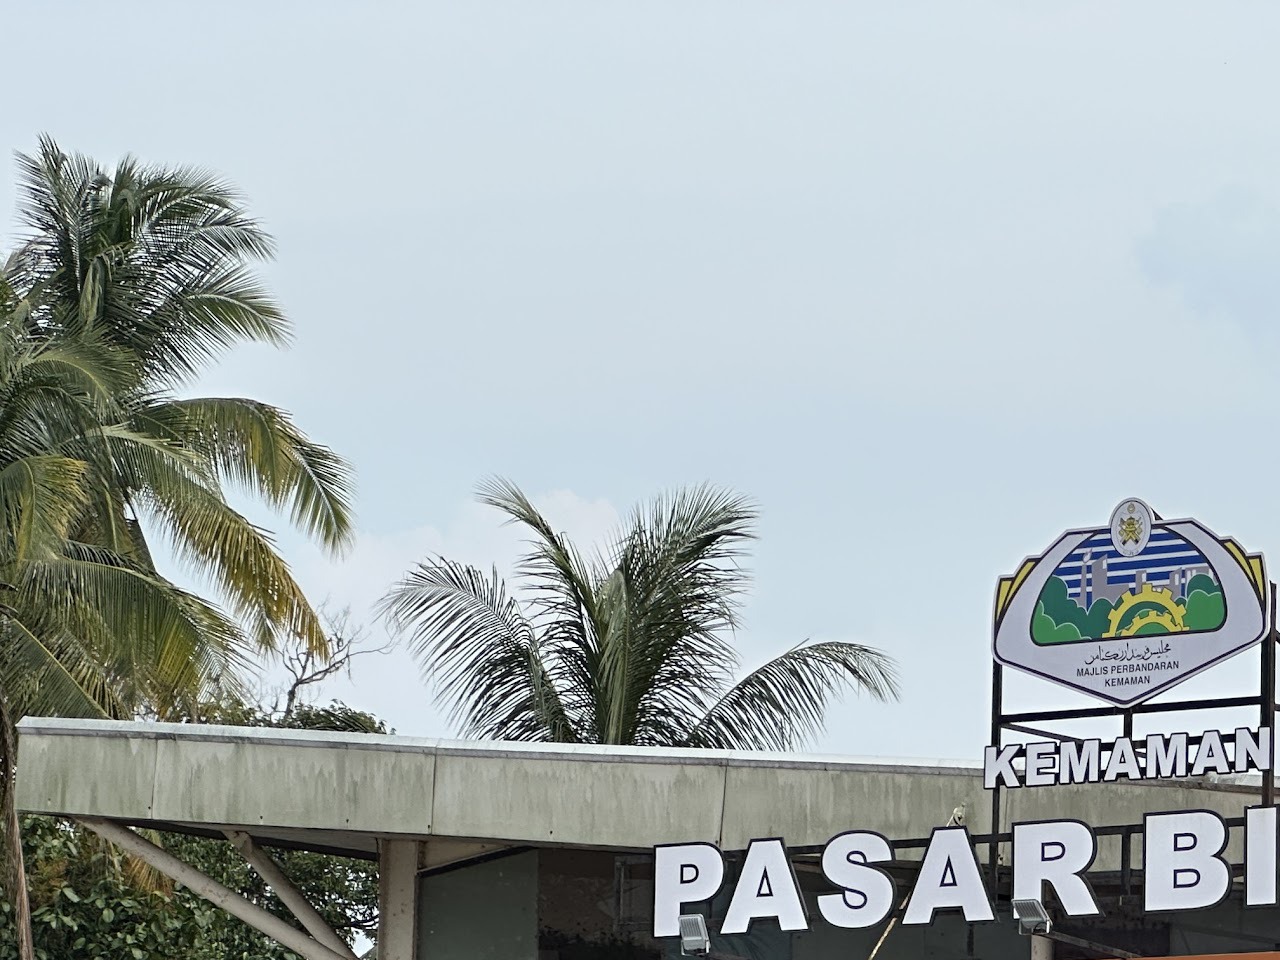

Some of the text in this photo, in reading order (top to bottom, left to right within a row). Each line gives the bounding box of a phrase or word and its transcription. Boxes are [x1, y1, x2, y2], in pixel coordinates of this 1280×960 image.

[1077, 661, 1179, 677] MAJLIS PERBANDARAN
[1104, 676, 1150, 687] KEMAMAN
[983, 727, 1271, 789] KEMAMAN
[653, 818, 1104, 938] PASAR
